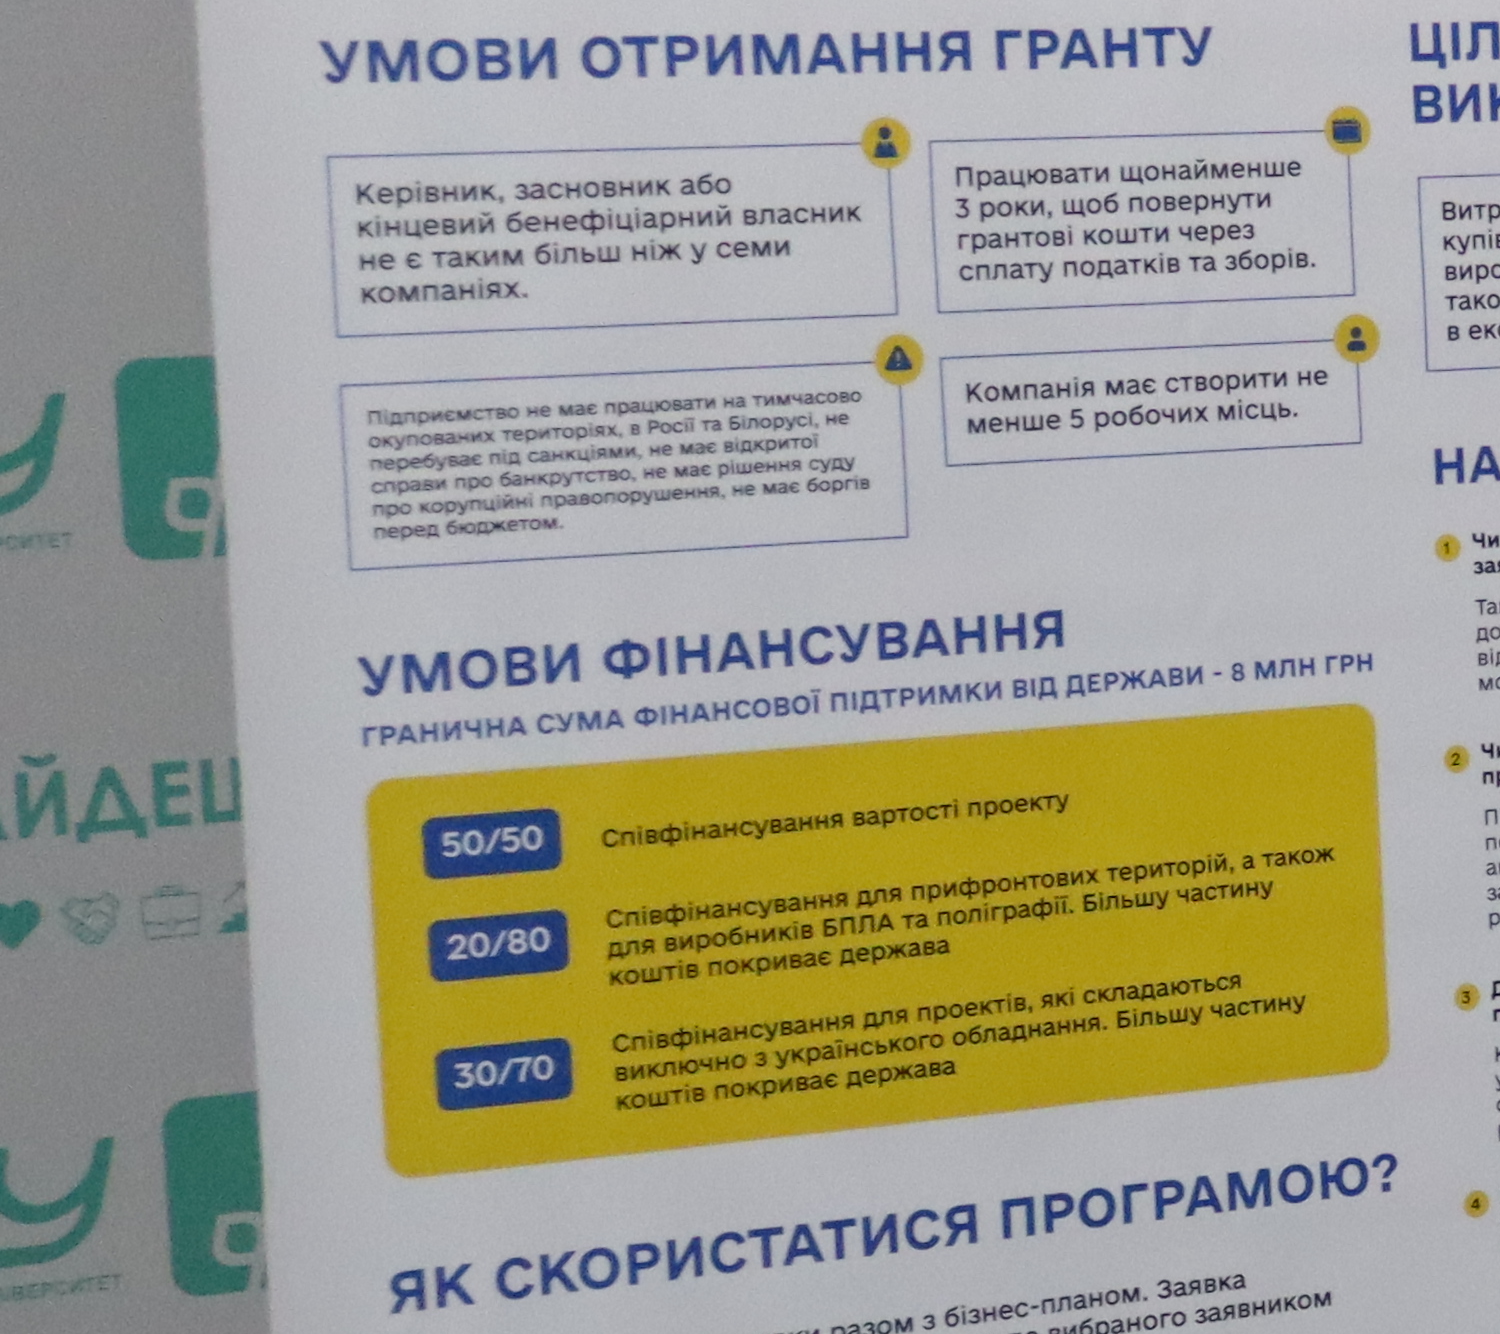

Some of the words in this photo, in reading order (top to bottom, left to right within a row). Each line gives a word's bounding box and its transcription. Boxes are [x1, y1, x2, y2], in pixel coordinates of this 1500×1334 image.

[320, 37, 557, 83] УМОВИ
[581, 30, 971, 79] ОТРИМАННЯ
[996, 26, 1212, 70] ГРАНТУ
[966, 377, 1095, 403] Компанія
[1105, 378, 1156, 395] має
[1165, 372, 1287, 394] створити
[1297, 370, 1328, 386] не
[967, 414, 1061, 434] менше
[1070, 408, 1084, 429] 5
[1094, 404, 1208, 432] робочих
[1217, 399, 1298, 421] місць.
[358, 643, 580, 697] УМОВИ
[603, 610, 1064, 679] ФІНАНСУВАННЯ
[602, 813, 844, 848] Співфінансування
[852, 800, 959, 828] вартості
[968, 794, 1069, 820] проекту
[442, 825, 544, 858] 50/50
[447, 926, 551, 960] 20/80
[454, 1055, 555, 1089] 30/70
[390, 1264, 474, 1313] ЯК
[496, 1204, 978, 1300] СКОРИСТАТИСЯ
[1001, 1153, 1397, 1239] ПРОГРАМОЮ?
